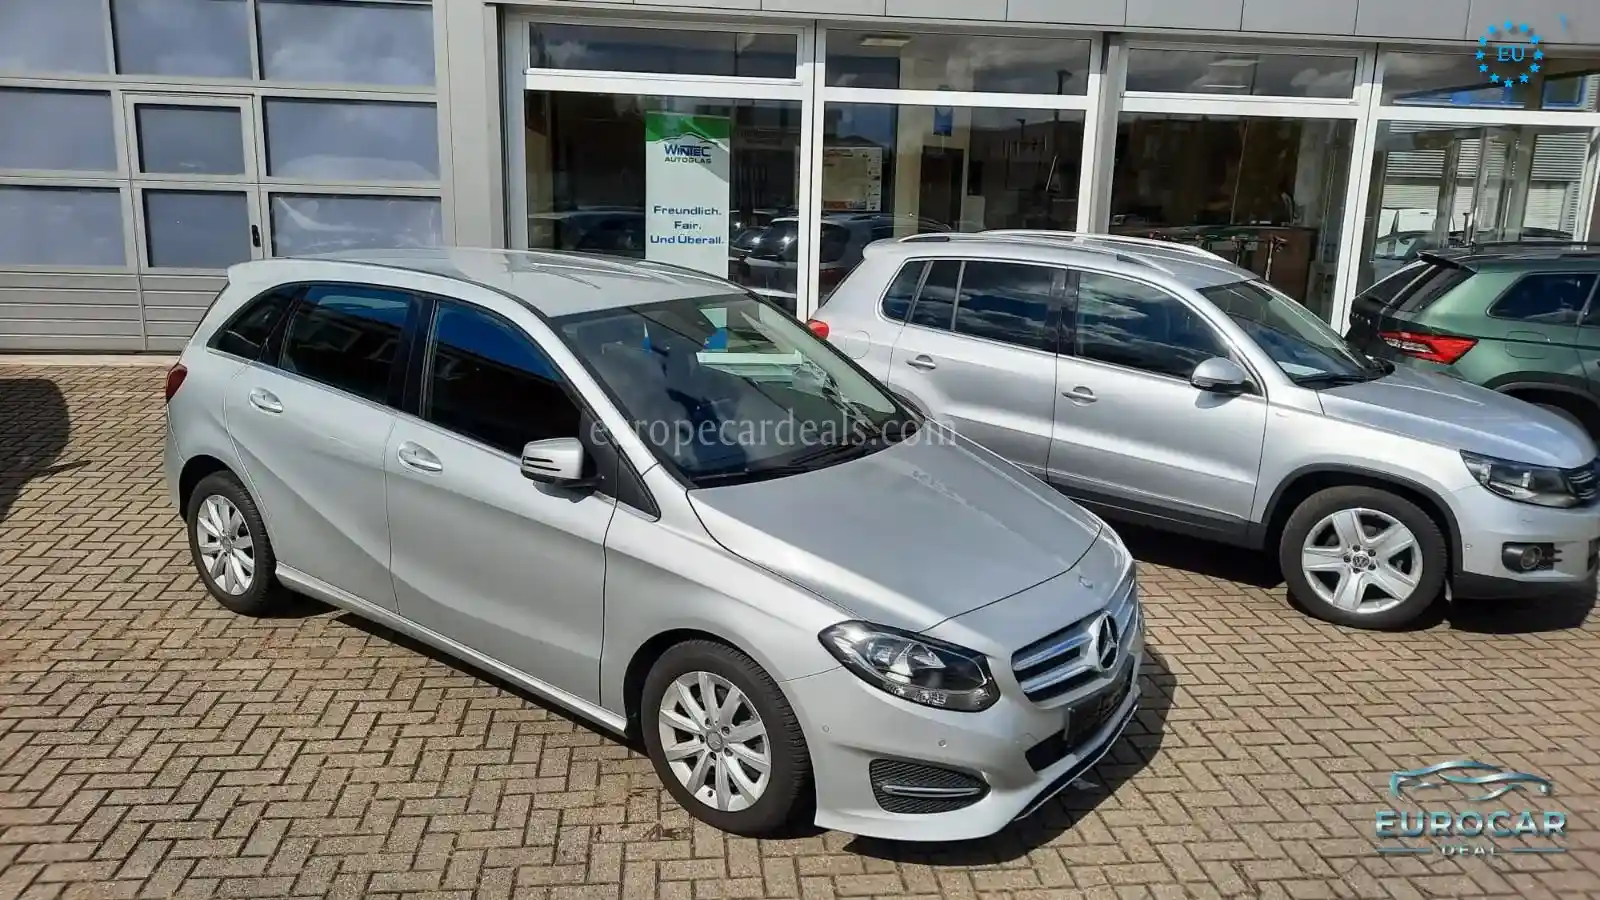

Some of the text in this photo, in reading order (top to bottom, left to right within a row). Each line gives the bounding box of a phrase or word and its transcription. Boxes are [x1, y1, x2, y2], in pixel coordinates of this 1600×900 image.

[664, 156, 712, 164] AUTOGLAS
[653, 206, 722, 216] Freundlich.
[674, 221, 702, 231] Fair.
[650, 233, 724, 245] Und Überall.
